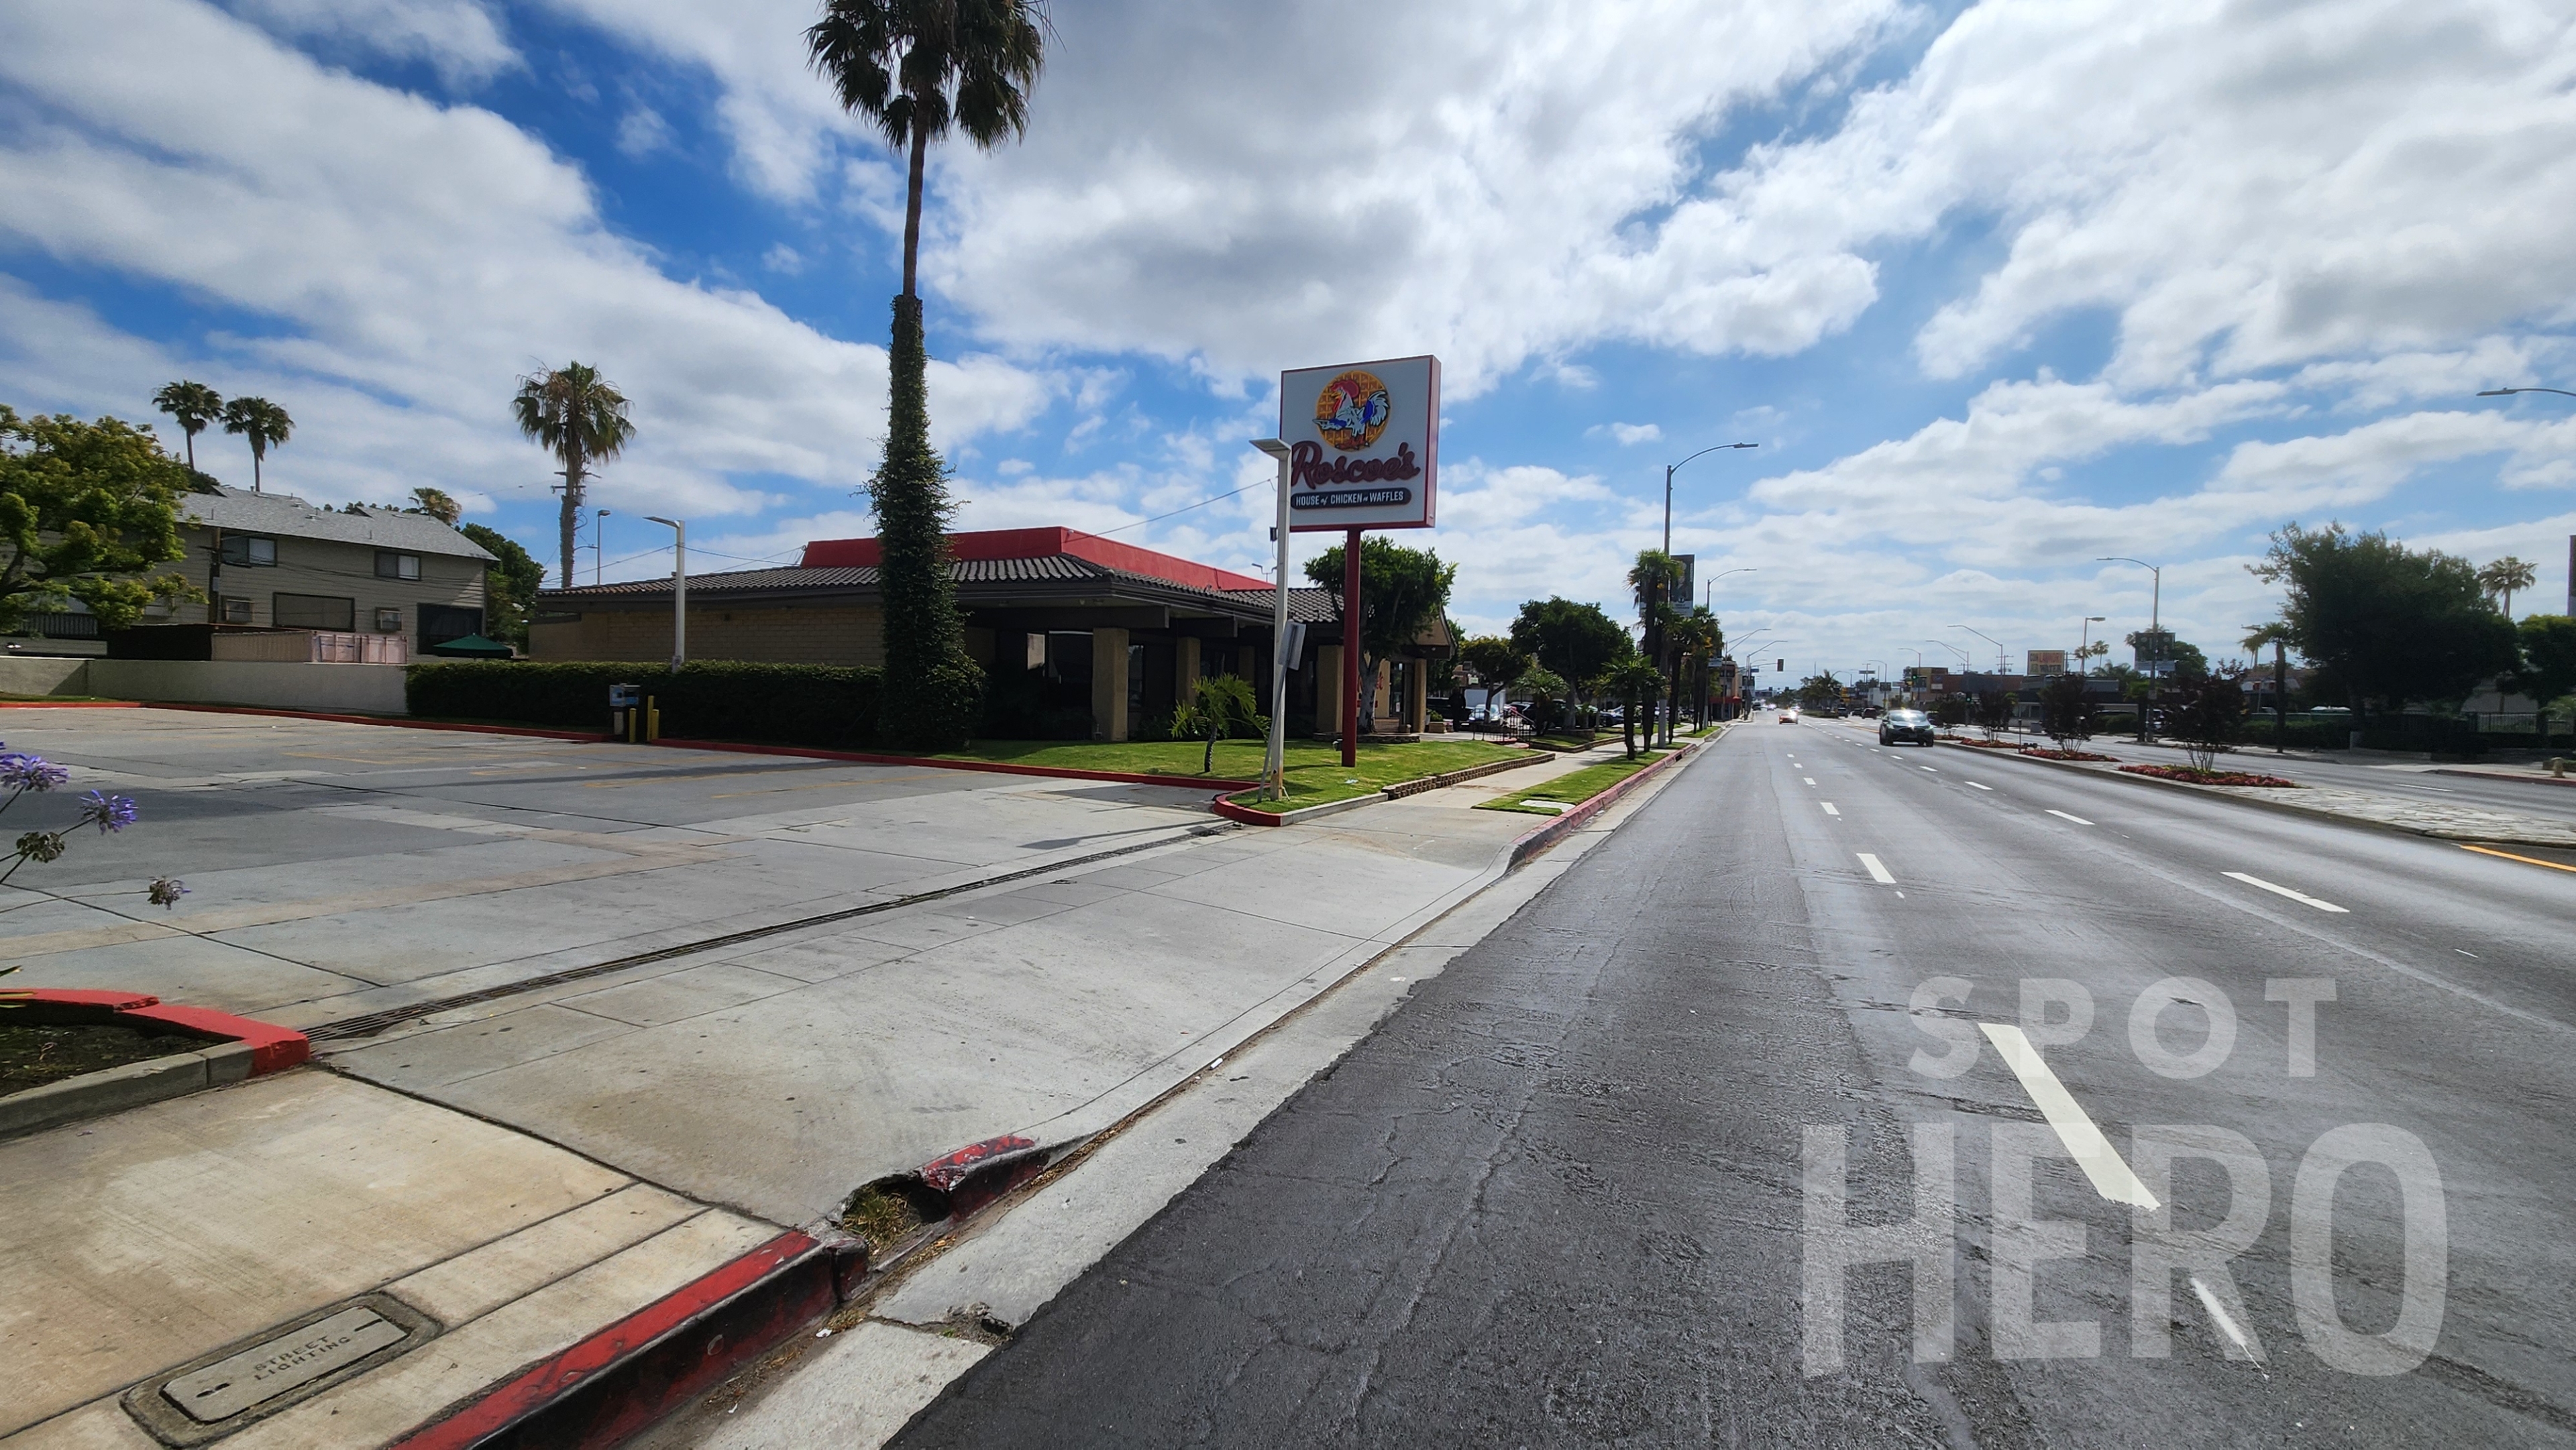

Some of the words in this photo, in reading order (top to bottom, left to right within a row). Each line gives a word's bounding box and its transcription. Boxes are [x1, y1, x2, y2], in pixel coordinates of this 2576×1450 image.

[1291, 440, 1421, 490] Roscoe's
[1296, 495, 1320, 506] HOUSE
[1320, 497, 1328, 506] of
[1330, 493, 1362, 504] CHICKEN
[1369, 491, 1404, 502] WAFFLES
[254, 1337, 350, 1380] LIGHTING
[255, 1335, 328, 1370] STREET
